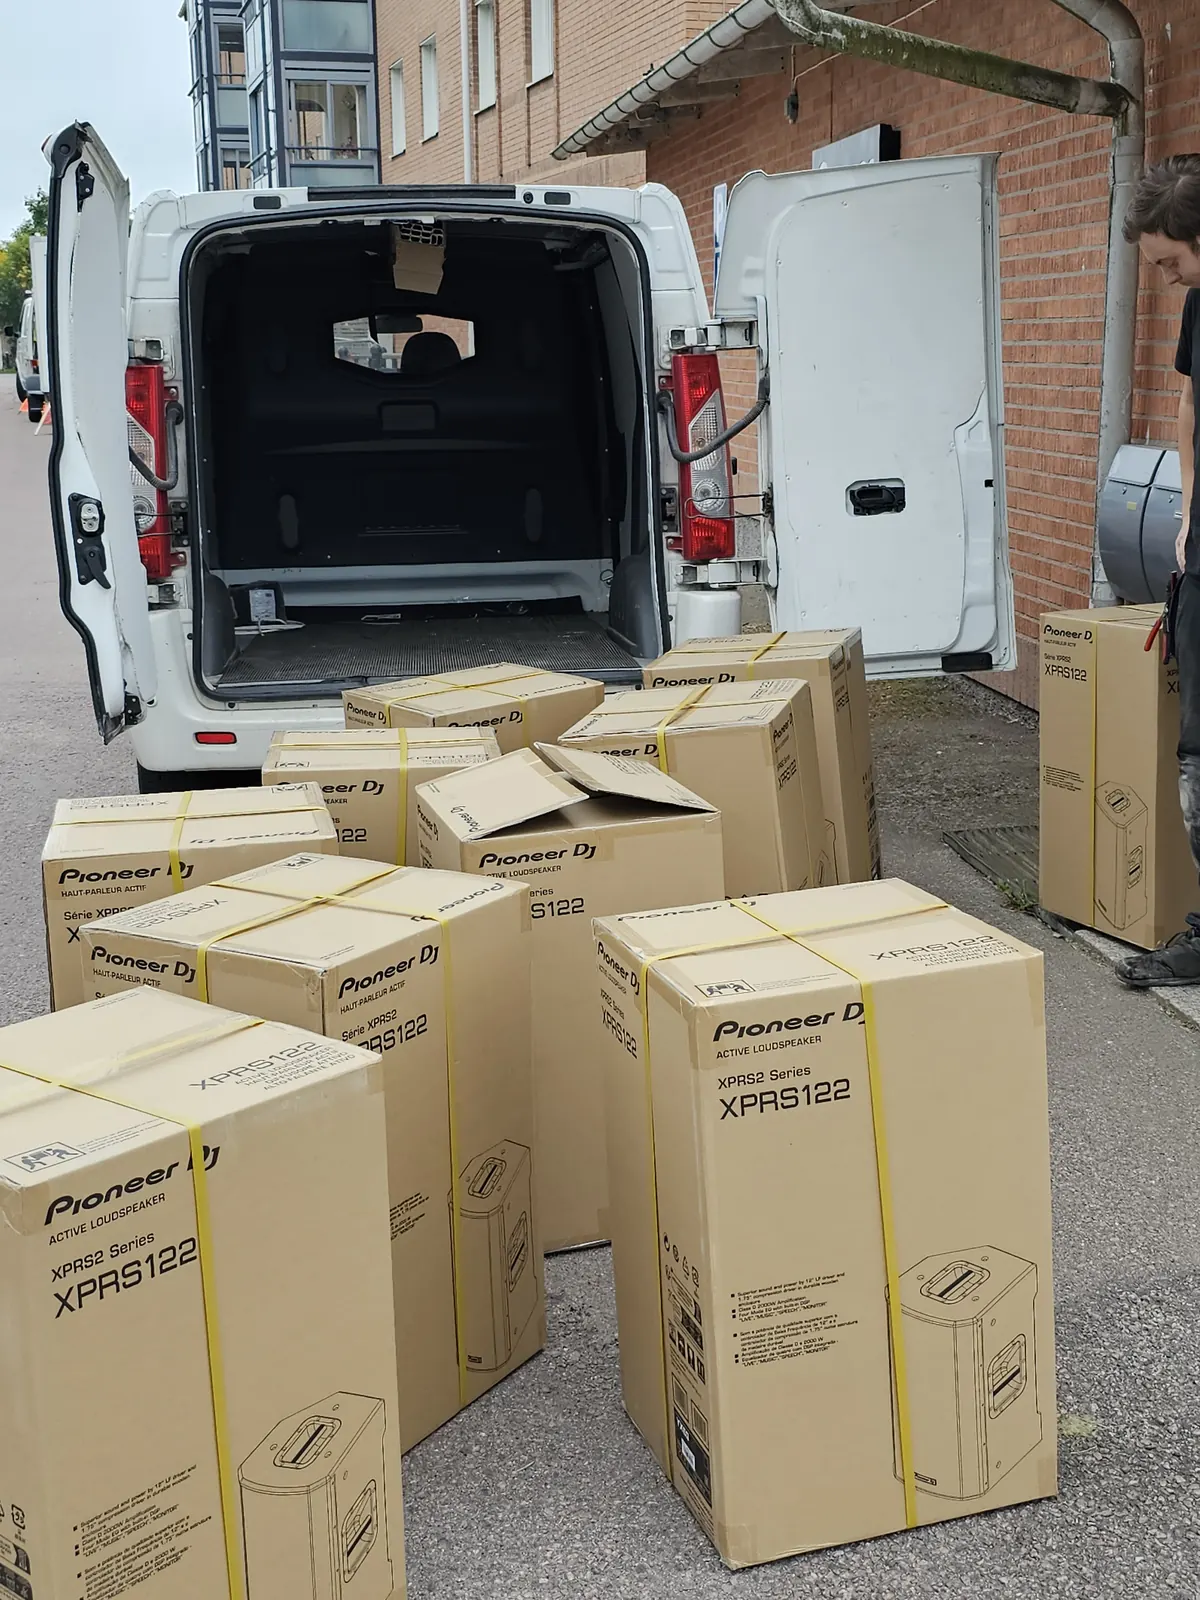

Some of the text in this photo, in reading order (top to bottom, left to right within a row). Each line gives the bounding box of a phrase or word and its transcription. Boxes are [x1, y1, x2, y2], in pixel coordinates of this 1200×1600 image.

[1043, 624, 1083, 639] Pioneer
[652, 677, 715, 688] Pioneer
[1044, 663, 1087, 682] XPRS122
[347, 702, 377, 719] Pioneer
[448, 716, 506, 728] neer
[478, 849, 568, 869] Pioneer
[509, 865, 562, 878] LOUDSPEAKER
[58, 867, 161, 885] Pioneer
[61, 884, 147, 898] HAUT-PARLEUR ACTIF
[437, 882, 504, 913] Pioneer
[529, 888, 554, 898] eries
[63, 910, 93, 921] Série
[531, 897, 585, 920] S122
[91, 945, 169, 974] Pioneer
[868, 935, 999, 961] XPRS122
[597, 941, 629, 981] Pioneer
[92, 968, 141, 984] HAUT-PARLEUR
[338, 956, 416, 1000] Pioneer
[340, 979, 406, 1015] HAUT-PARLEUR ACTIF
[342, 1008, 398, 1042] Série XPRS2
[601, 1005, 638, 1060] XPRS122
[713, 1012, 836, 1042] Pioneer
[716, 1035, 822, 1060] ACTIVE LOUDSPEAKER
[189, 1041, 323, 1091] XPRS122
[717, 1066, 811, 1090] XPRS2 Series
[719, 1078, 851, 1120] XPRS122
[44, 1161, 180, 1226] Pioneer
[49, 1192, 166, 1246] ACTIVE LOUDSPEAKER
[51, 1232, 155, 1283] XPRS2 Series
[53, 1236, 198, 1319] XPRS122
